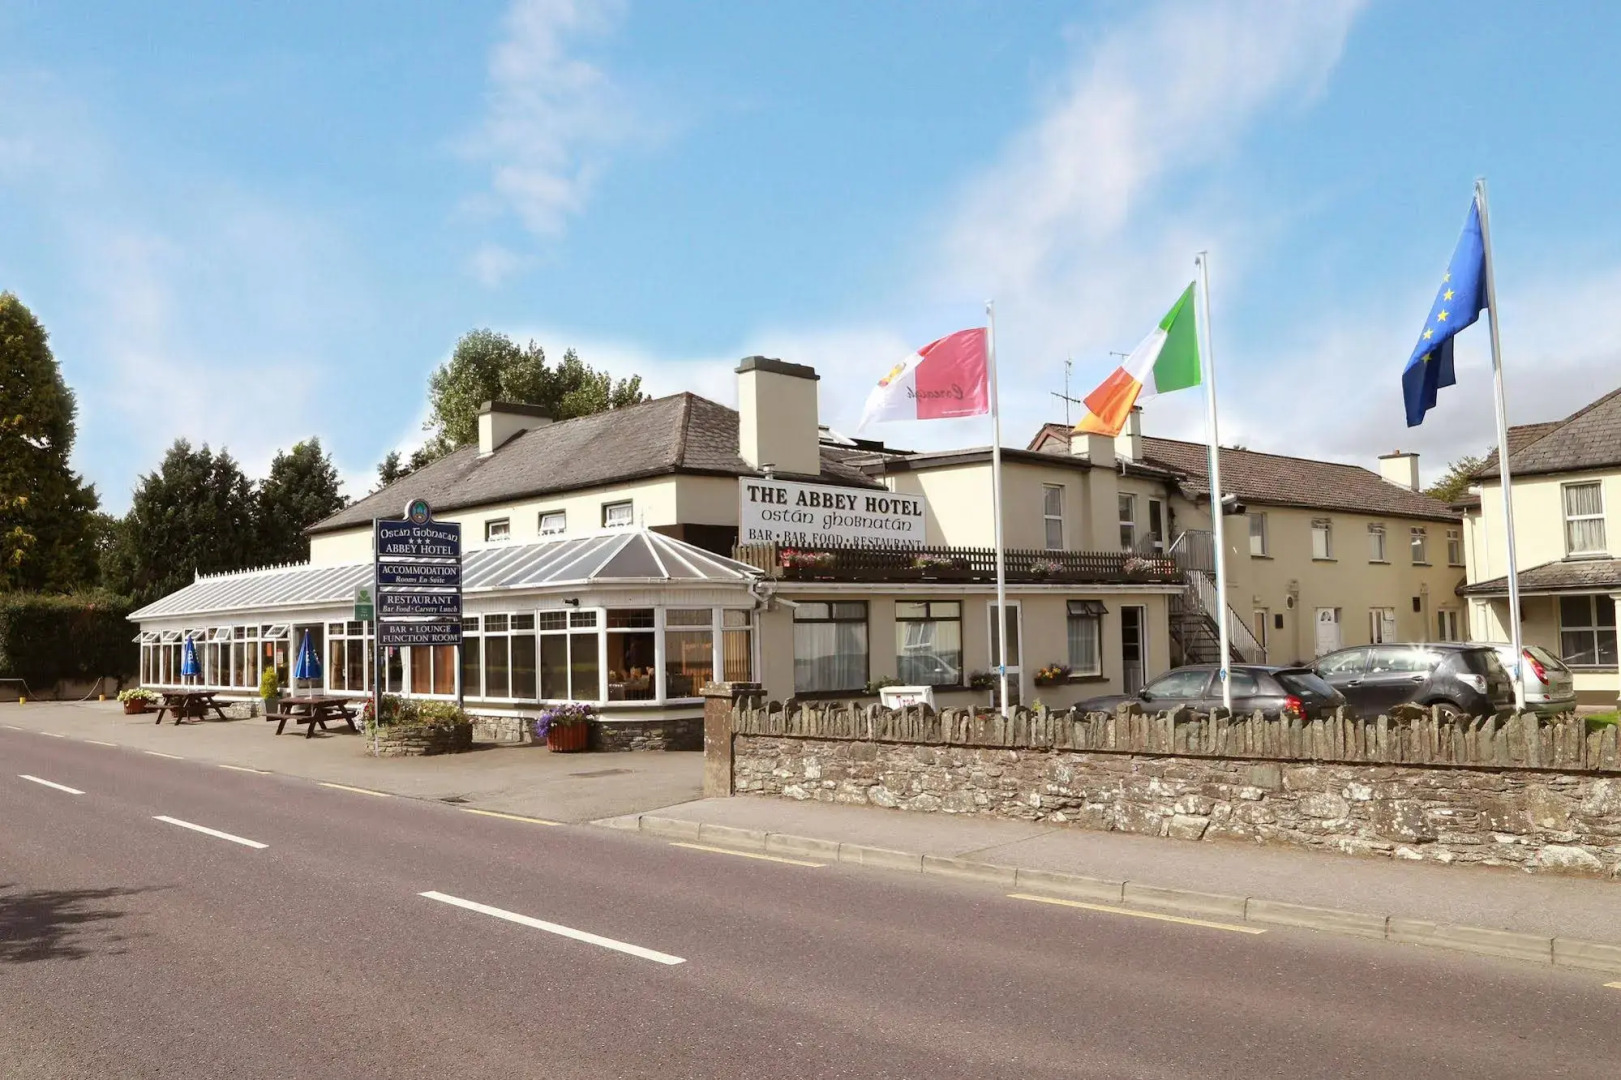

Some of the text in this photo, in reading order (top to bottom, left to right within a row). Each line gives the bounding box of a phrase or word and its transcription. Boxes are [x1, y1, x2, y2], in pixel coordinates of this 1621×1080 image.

[747, 485, 922, 516] THE ABBEY HOTEL
[748, 529, 921, 548] BAR BAR FOOD RESTAURANT
[385, 544, 453, 555] ABBEY HOTEL
[382, 566, 457, 576] ACCOMMODATION
[429, 576, 445, 584] Suite
[387, 595, 453, 605] RESTAURANT
[414, 606, 437, 614] Carvery
[389, 625, 452, 633] BAR LOUNGE
[382, 634, 458, 643] FUNCTION ROOM
